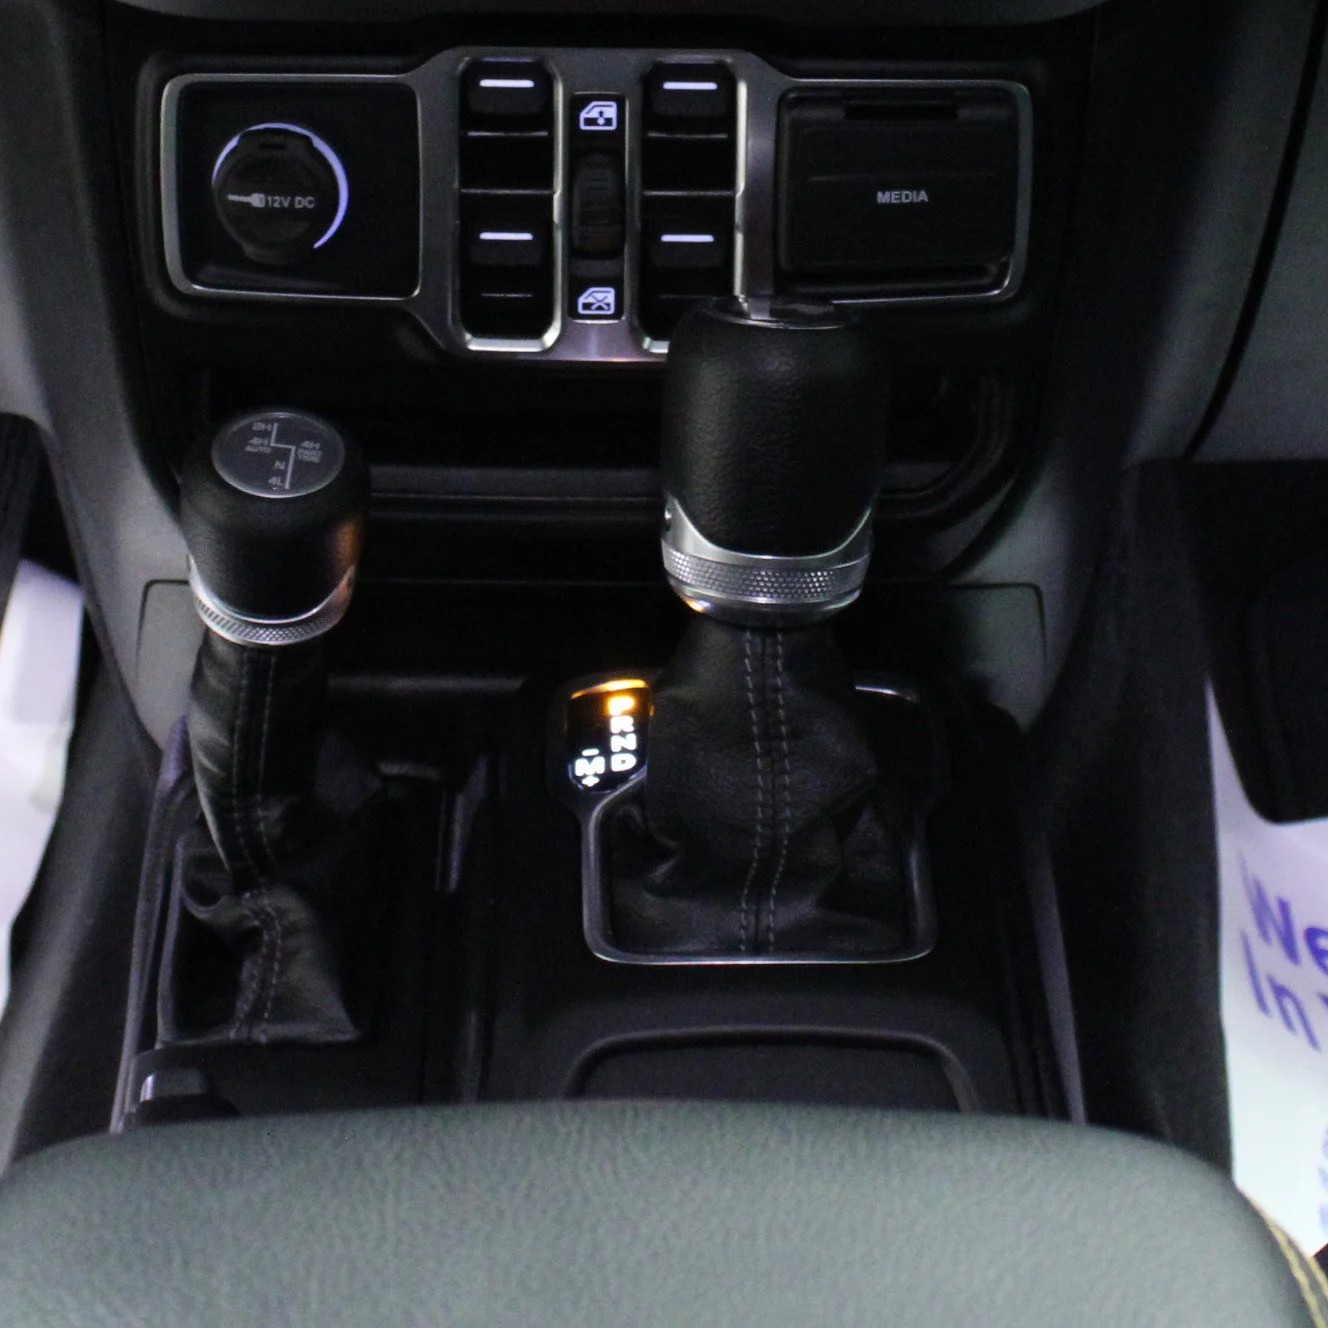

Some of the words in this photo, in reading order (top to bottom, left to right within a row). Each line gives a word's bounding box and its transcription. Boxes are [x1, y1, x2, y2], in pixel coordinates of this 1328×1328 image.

[266, 195, 291, 208] 12V
[294, 196, 316, 209] DC
[876, 190, 929, 204] MEDIA
[608, 696, 635, 716] P
[610, 733, 637, 752] N
[575, 756, 605, 776] M
[610, 753, 637, 772] D
[1240, 928, 1321, 1053] In
